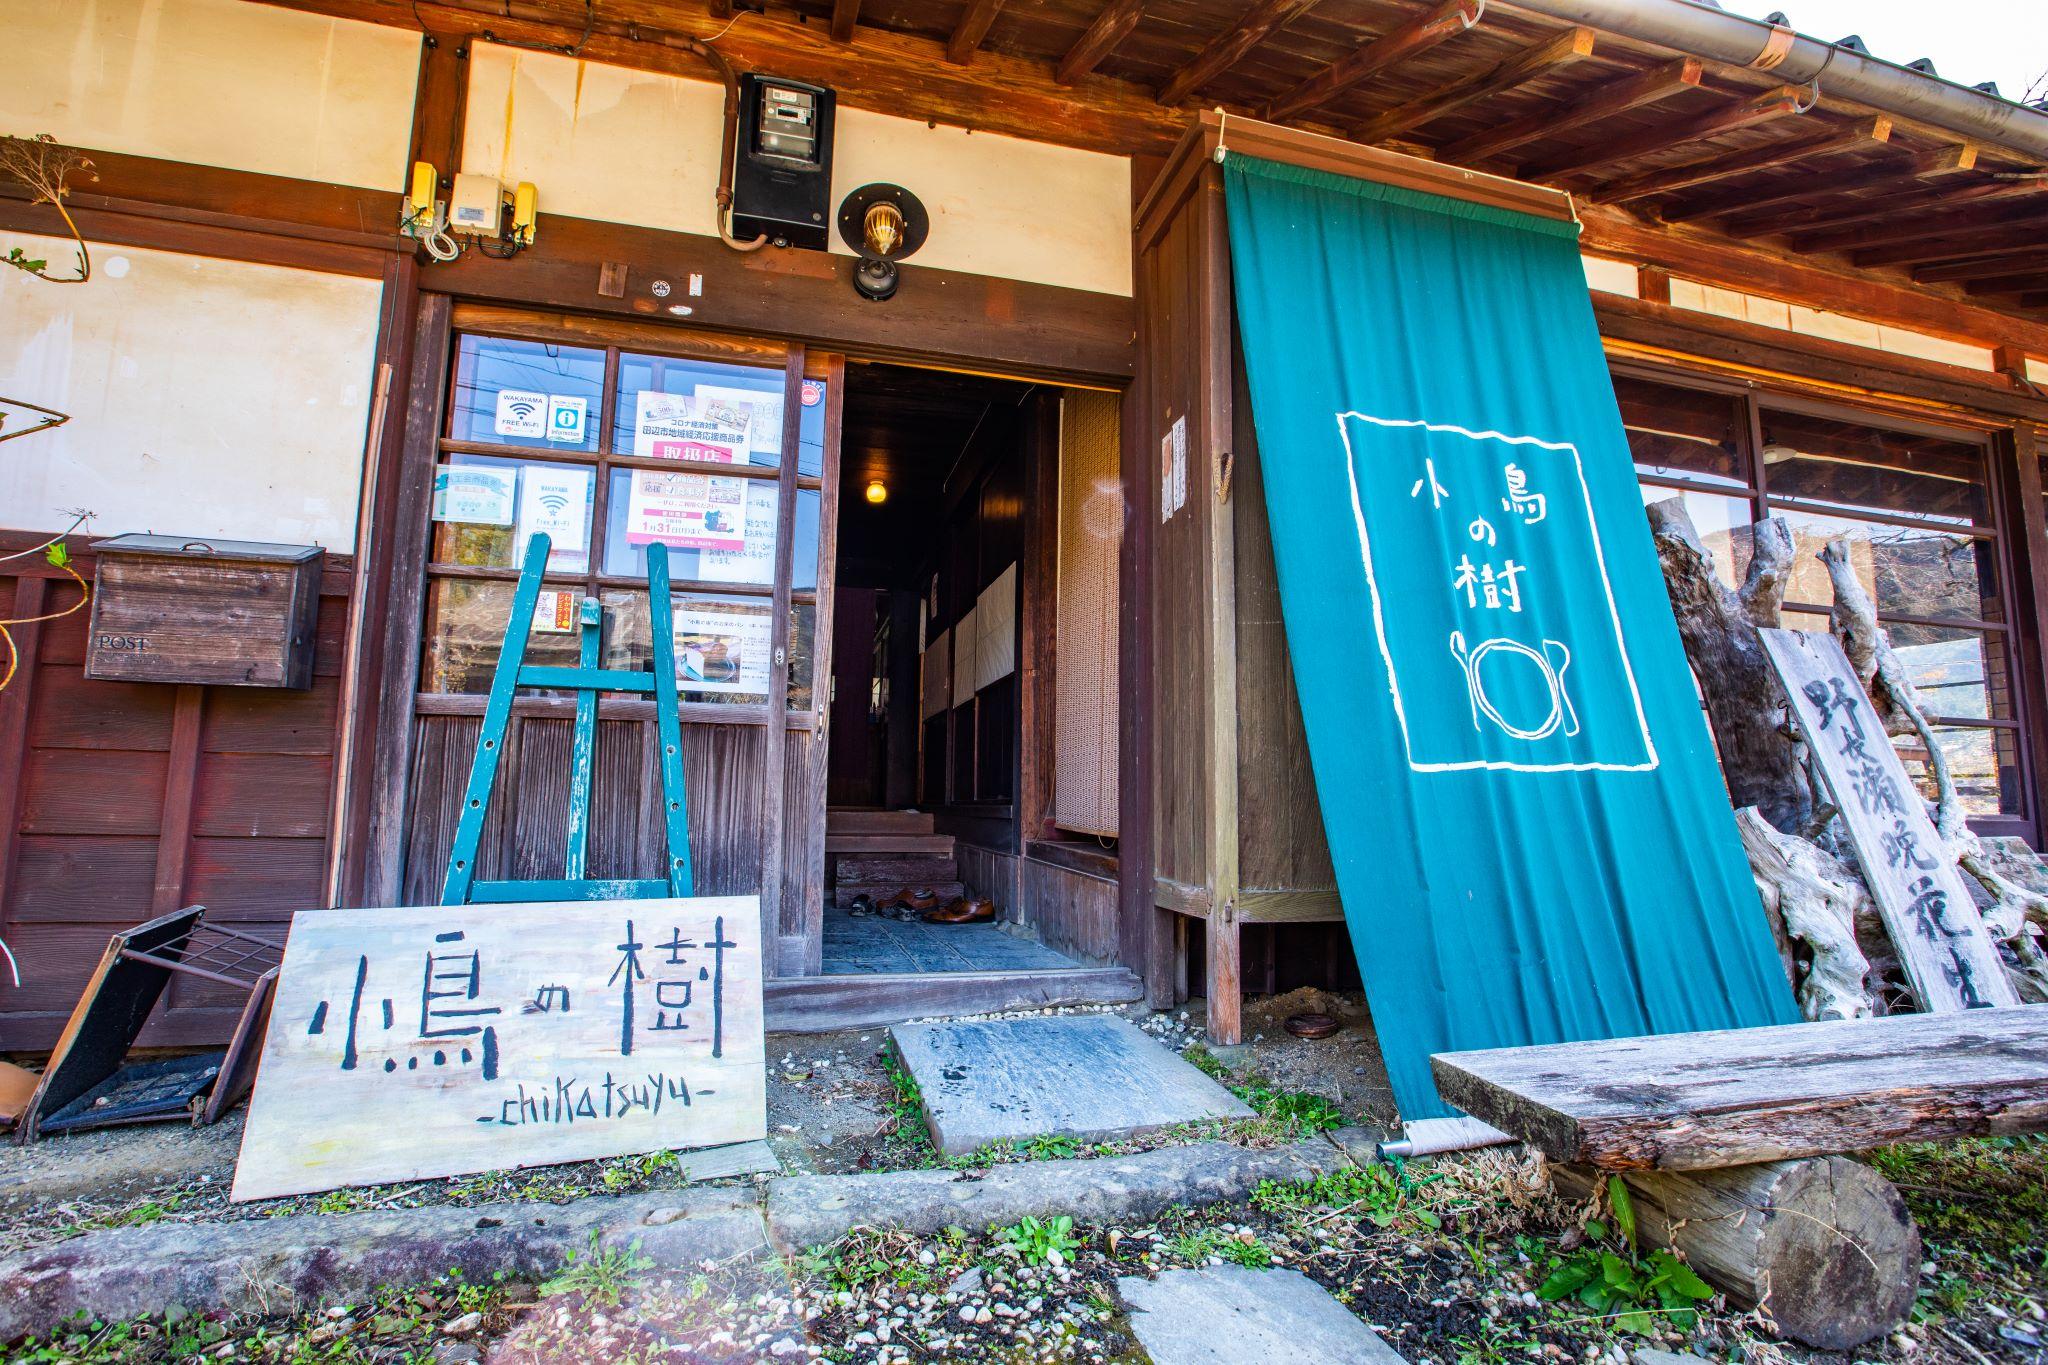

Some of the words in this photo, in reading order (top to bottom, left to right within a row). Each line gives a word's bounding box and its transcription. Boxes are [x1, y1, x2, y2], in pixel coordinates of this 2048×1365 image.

[503, 395, 543, 404] WAKAYAMA
[663, 445, 721, 463] 取扱店
[541, 485, 568, 493] WAKAYAMA
[99, 635, 149, 651] POST
[308, 915, 737, 1080] 小鳥の樹
